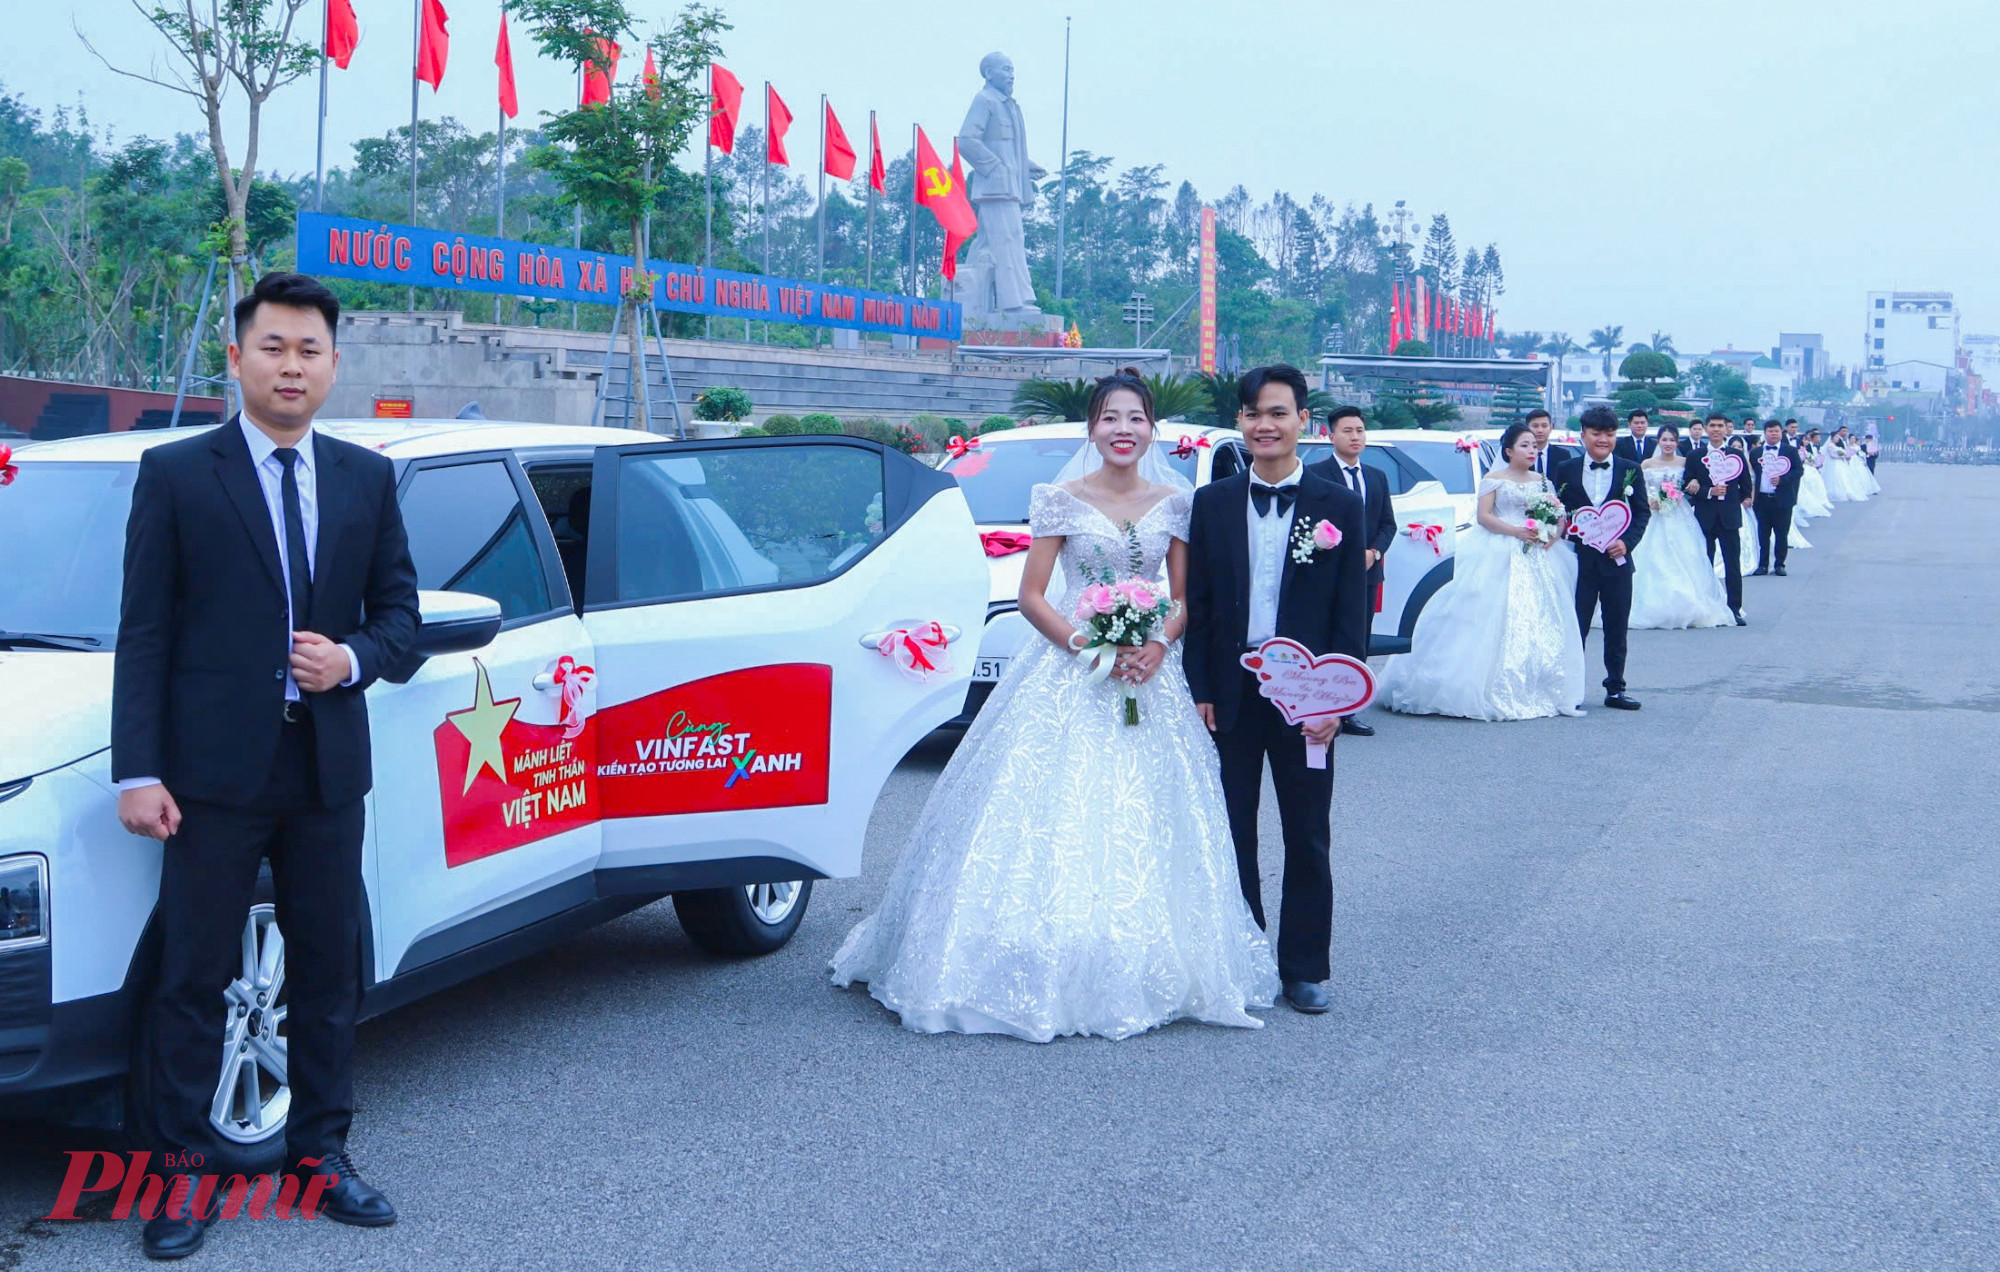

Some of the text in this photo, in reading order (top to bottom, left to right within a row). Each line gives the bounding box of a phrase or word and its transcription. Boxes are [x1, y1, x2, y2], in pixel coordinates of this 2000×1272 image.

[329, 224, 411, 271] NƯỚC
[432, 236, 504, 284] CỘNG
[519, 247, 564, 288] HÒA
[578, 256, 607, 293] XÃ
[620, 266, 655, 299] HI
[666, 266, 705, 303] CHỦ
[716, 278, 769, 311] NGHĨA
[779, 284, 813, 319] VIỆT
[821, 293, 856, 321] NAM
[863, 296, 904, 326] MUÔN
[973, 662, 1000, 678] .51
[666, 710, 730, 746] Cùng
[513, 739, 573, 774] MÃNH LIỆT
[635, 733, 750, 760] VINFAST
[533, 768, 557, 788] TINH
[597, 749, 801, 788] KIẾN TẠO TƯƠNG LAI XANH
[502, 780, 586, 829] VIỆT NAM
